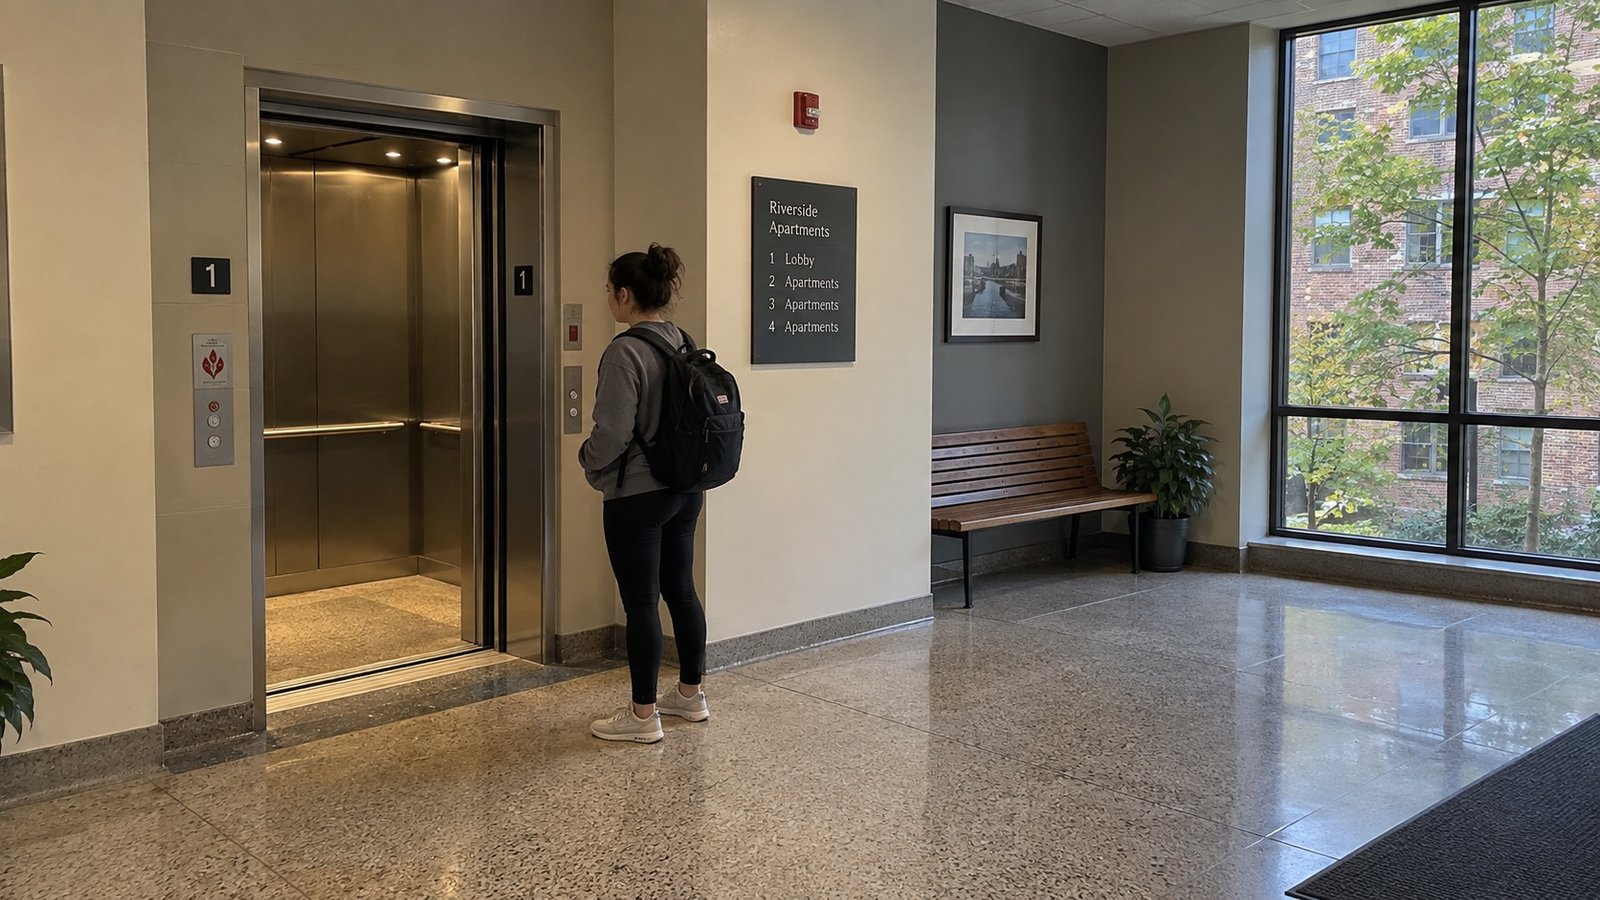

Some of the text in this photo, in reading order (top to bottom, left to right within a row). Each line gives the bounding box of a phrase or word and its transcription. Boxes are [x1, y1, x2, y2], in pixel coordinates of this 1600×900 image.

[769, 200, 818, 218] Riverside
[768, 220, 830, 238] Apartments
[769, 252, 815, 269] 1 Lobby
[205, 263, 215, 288] 1
[519, 270, 526, 290] 1
[768, 274, 839, 291] 2 Apartments
[768, 297, 839, 313] 3 Apartments
[768, 320, 839, 336] 4 Apartments
